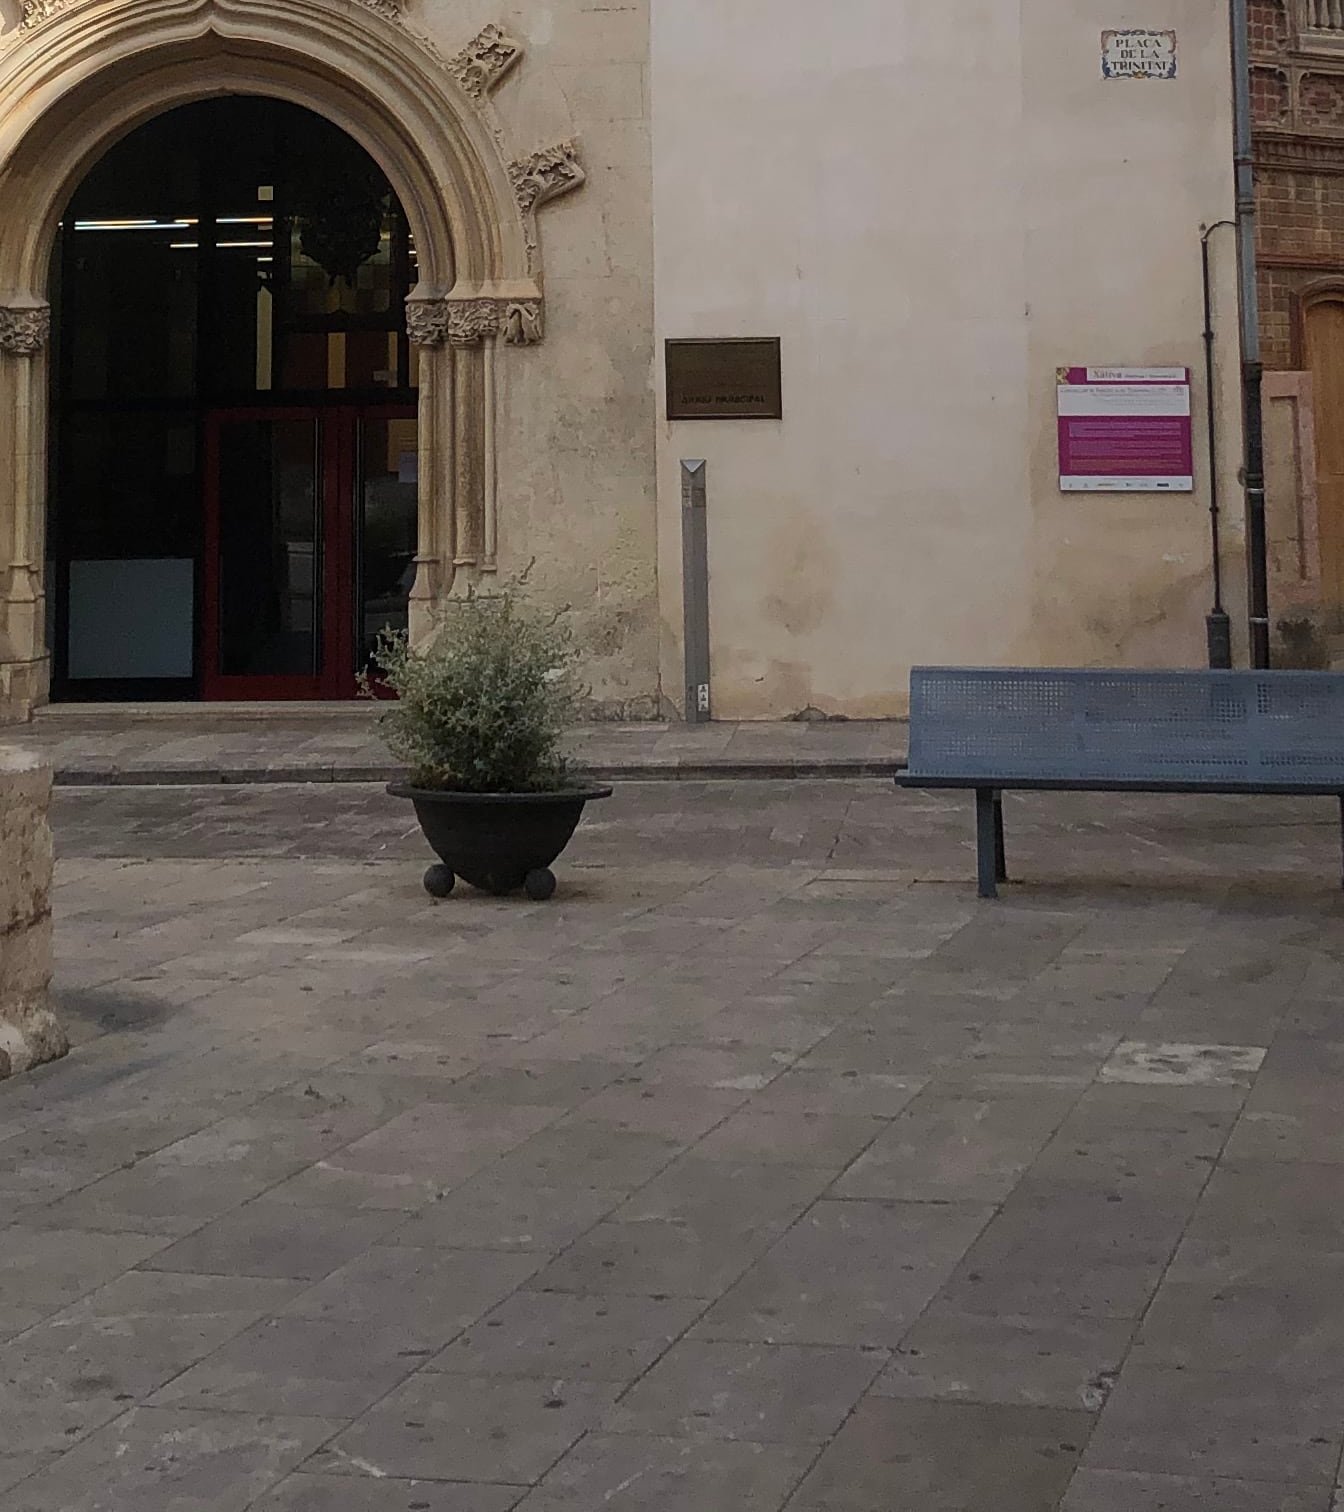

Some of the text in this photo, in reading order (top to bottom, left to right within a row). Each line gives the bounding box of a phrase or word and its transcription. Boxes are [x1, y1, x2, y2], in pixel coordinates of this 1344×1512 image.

[1120, 49, 1160, 59] DE LA
[1110, 60, 1169, 71] TRINITAT
